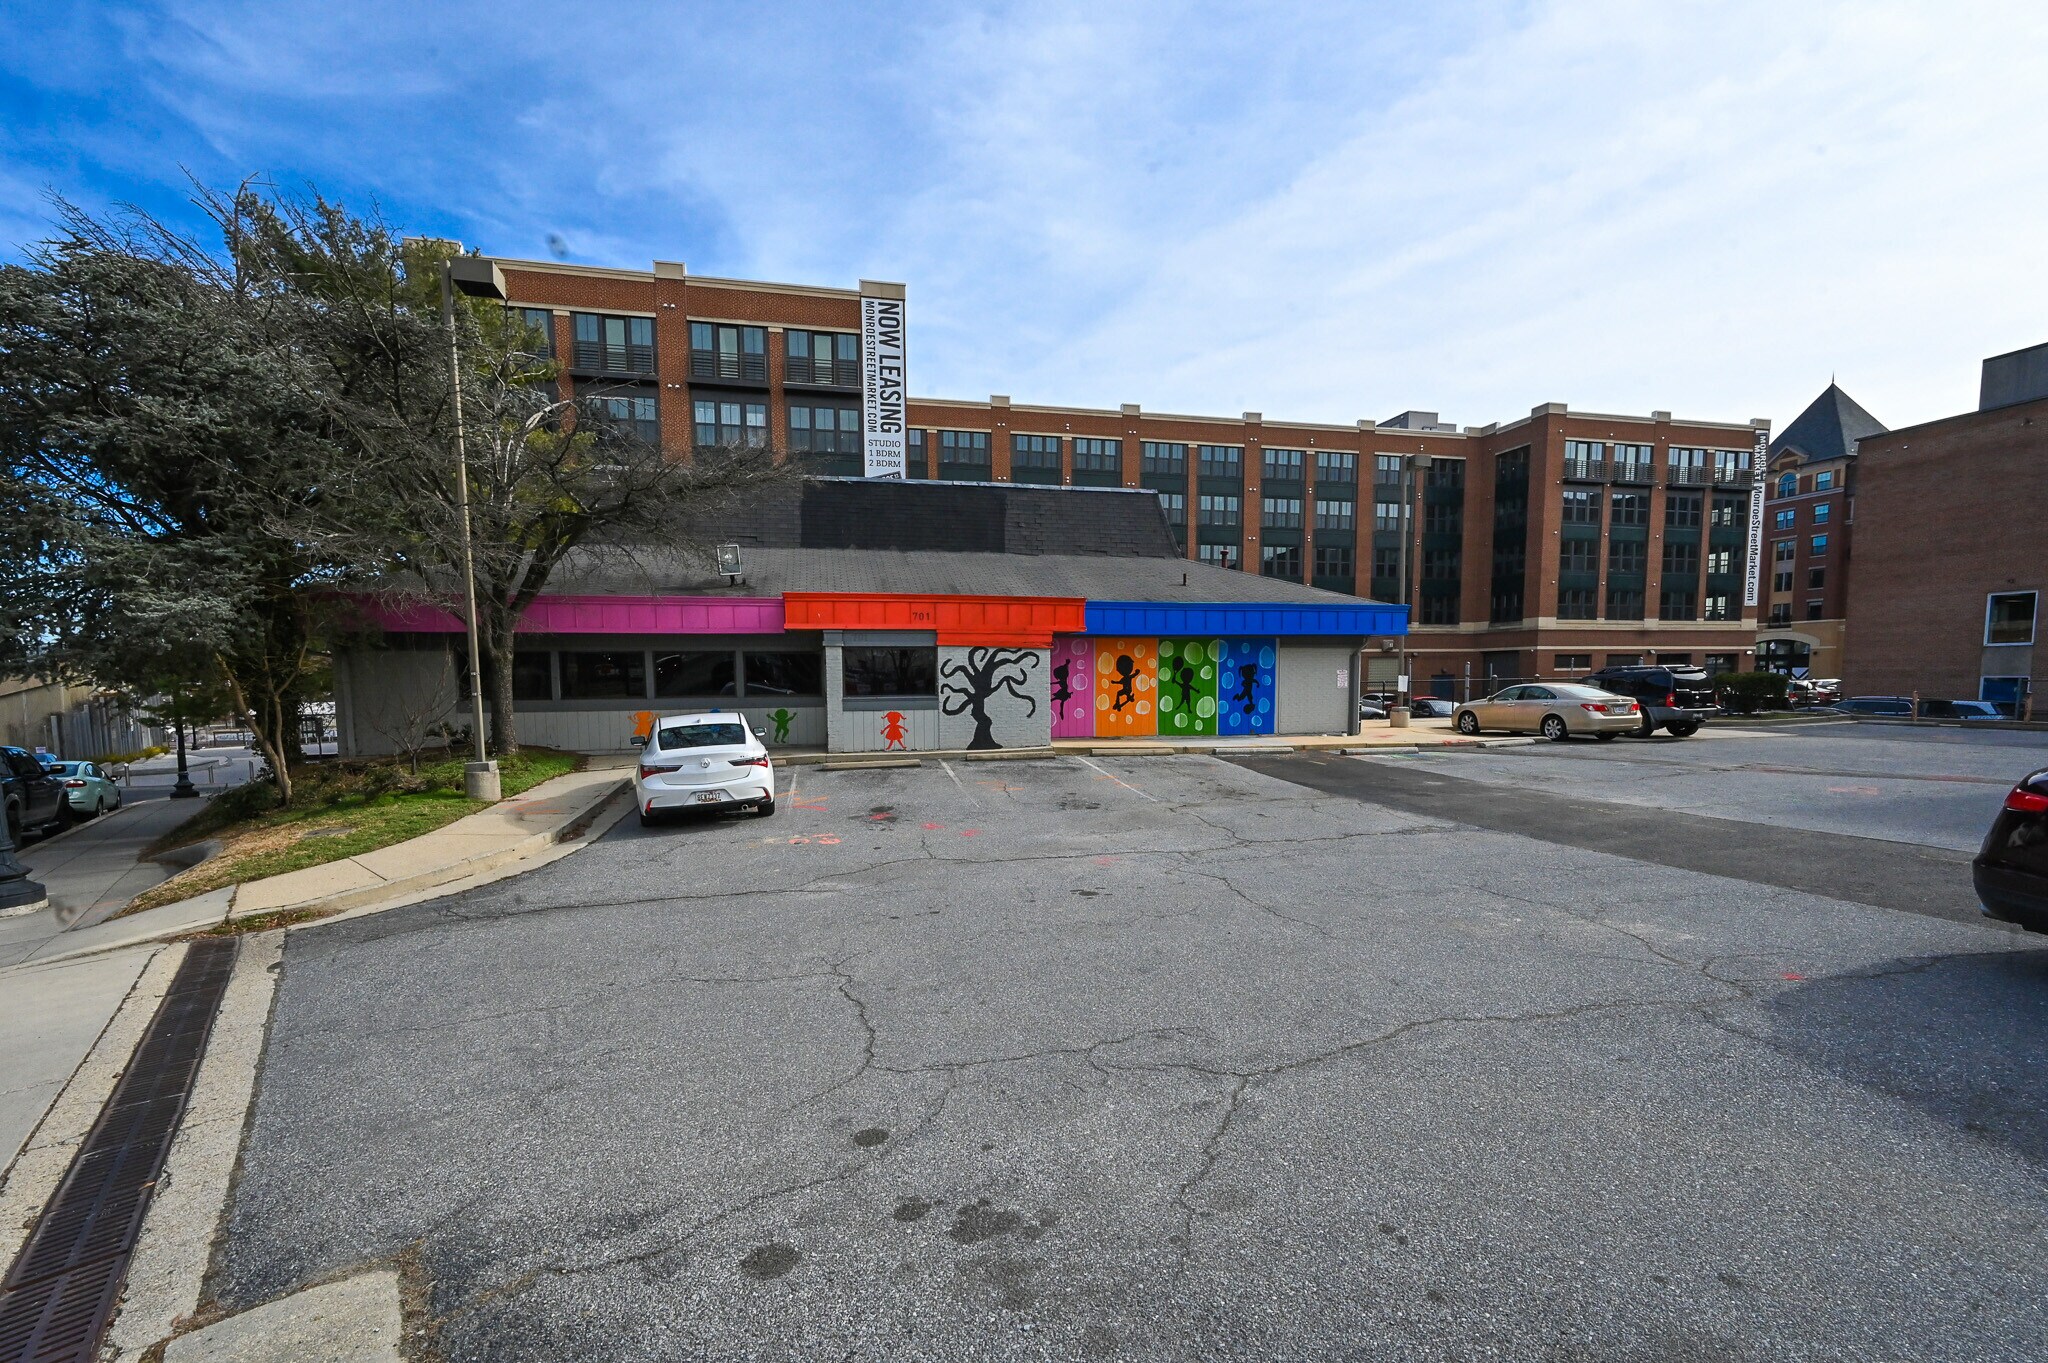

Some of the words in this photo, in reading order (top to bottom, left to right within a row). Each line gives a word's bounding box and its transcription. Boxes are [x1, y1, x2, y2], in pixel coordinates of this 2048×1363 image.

[878, 301, 900, 349] NOW
[865, 301, 877, 433] MONROESTREETMARKET.COM
[879, 355, 902, 434] LEASING
[868, 439, 901, 448] STUDIO
[869, 449, 874, 457] 1
[876, 450, 901, 458] BDRM
[1759, 435, 1767, 472] MONROE
[869, 459, 874, 467] 2
[876, 460, 901, 468] BDRM
[1746, 485, 1762, 601] MonroeStreetMarket.com
[912, 612, 930, 620] 701
